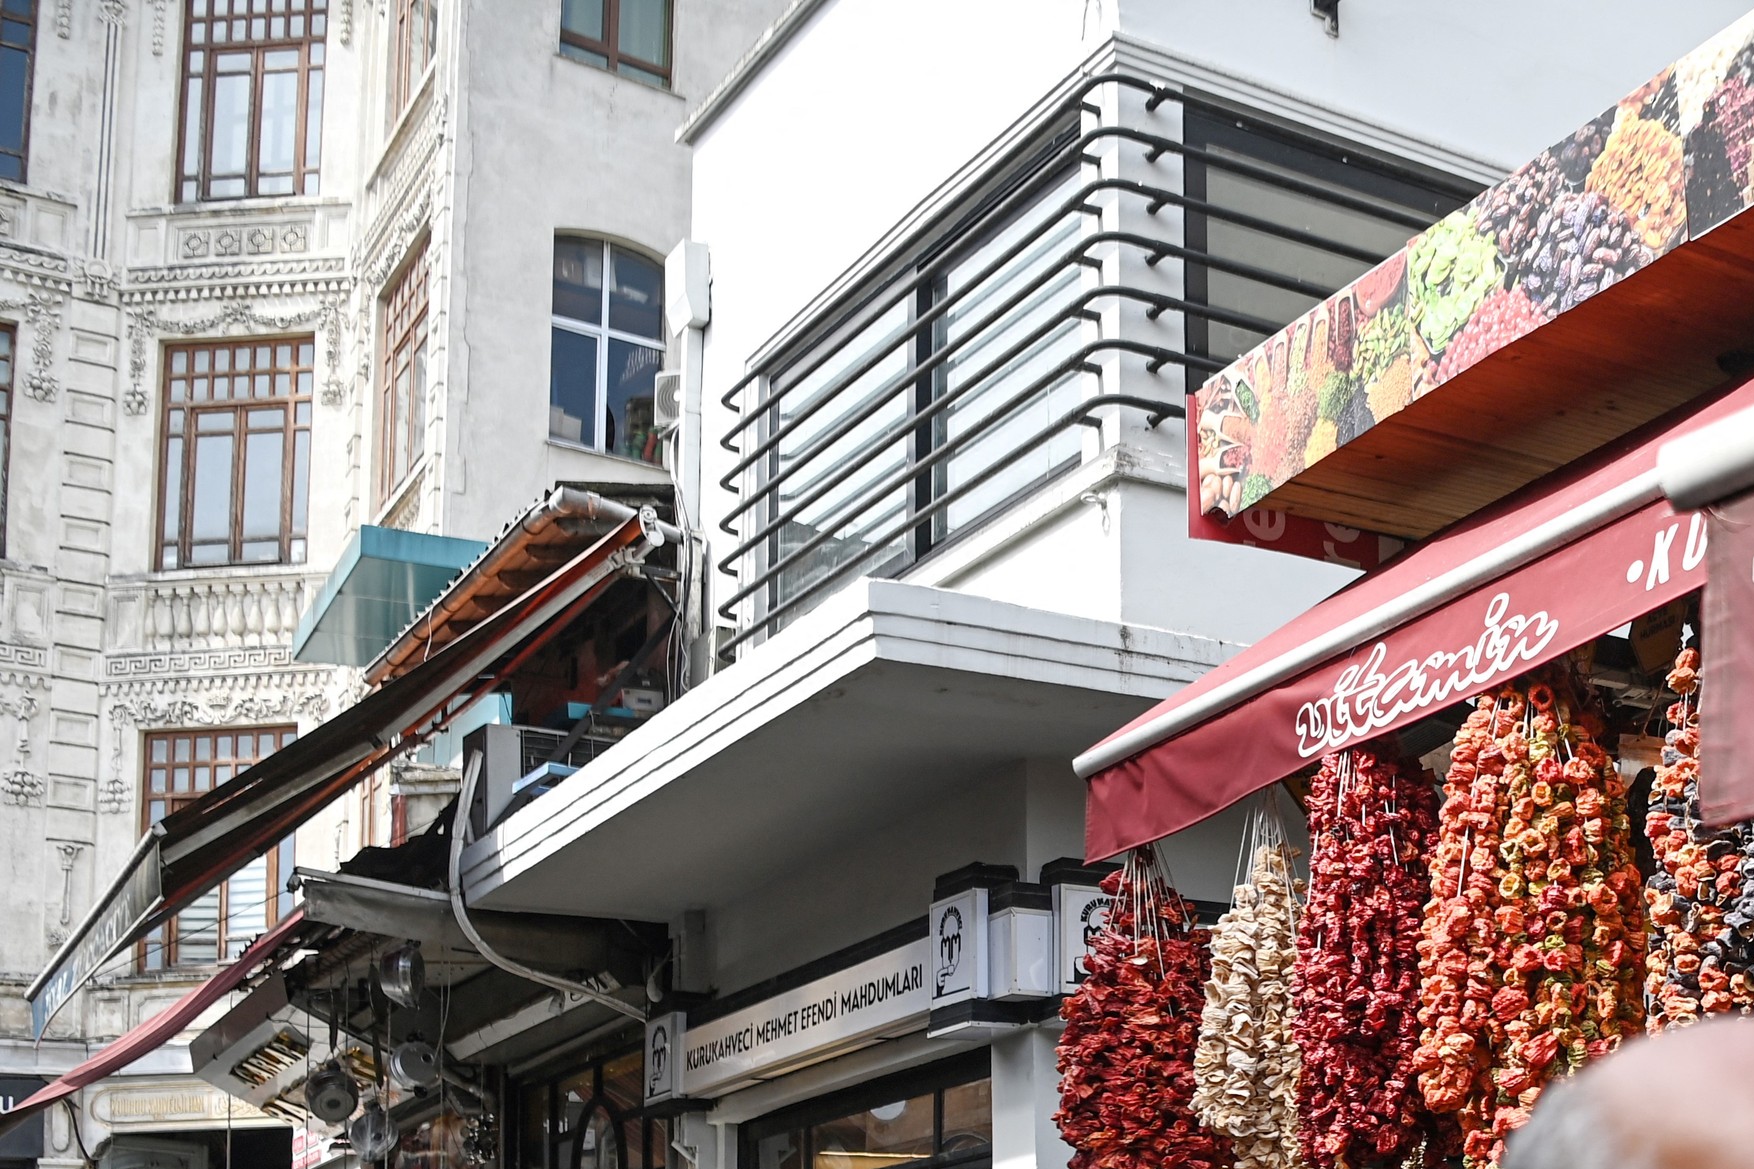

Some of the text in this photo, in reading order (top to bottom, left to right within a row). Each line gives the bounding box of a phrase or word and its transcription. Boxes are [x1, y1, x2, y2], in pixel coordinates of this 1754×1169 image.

[1295, 592, 1559, 758] vitamin
[686, 1023, 754, 1072] KURUKAHVECİ
[756, 1010, 799, 1046] MEHMET
[801, 991, 837, 1030] EFENDİ
[841, 963, 923, 1015] MAHDUMLARI
